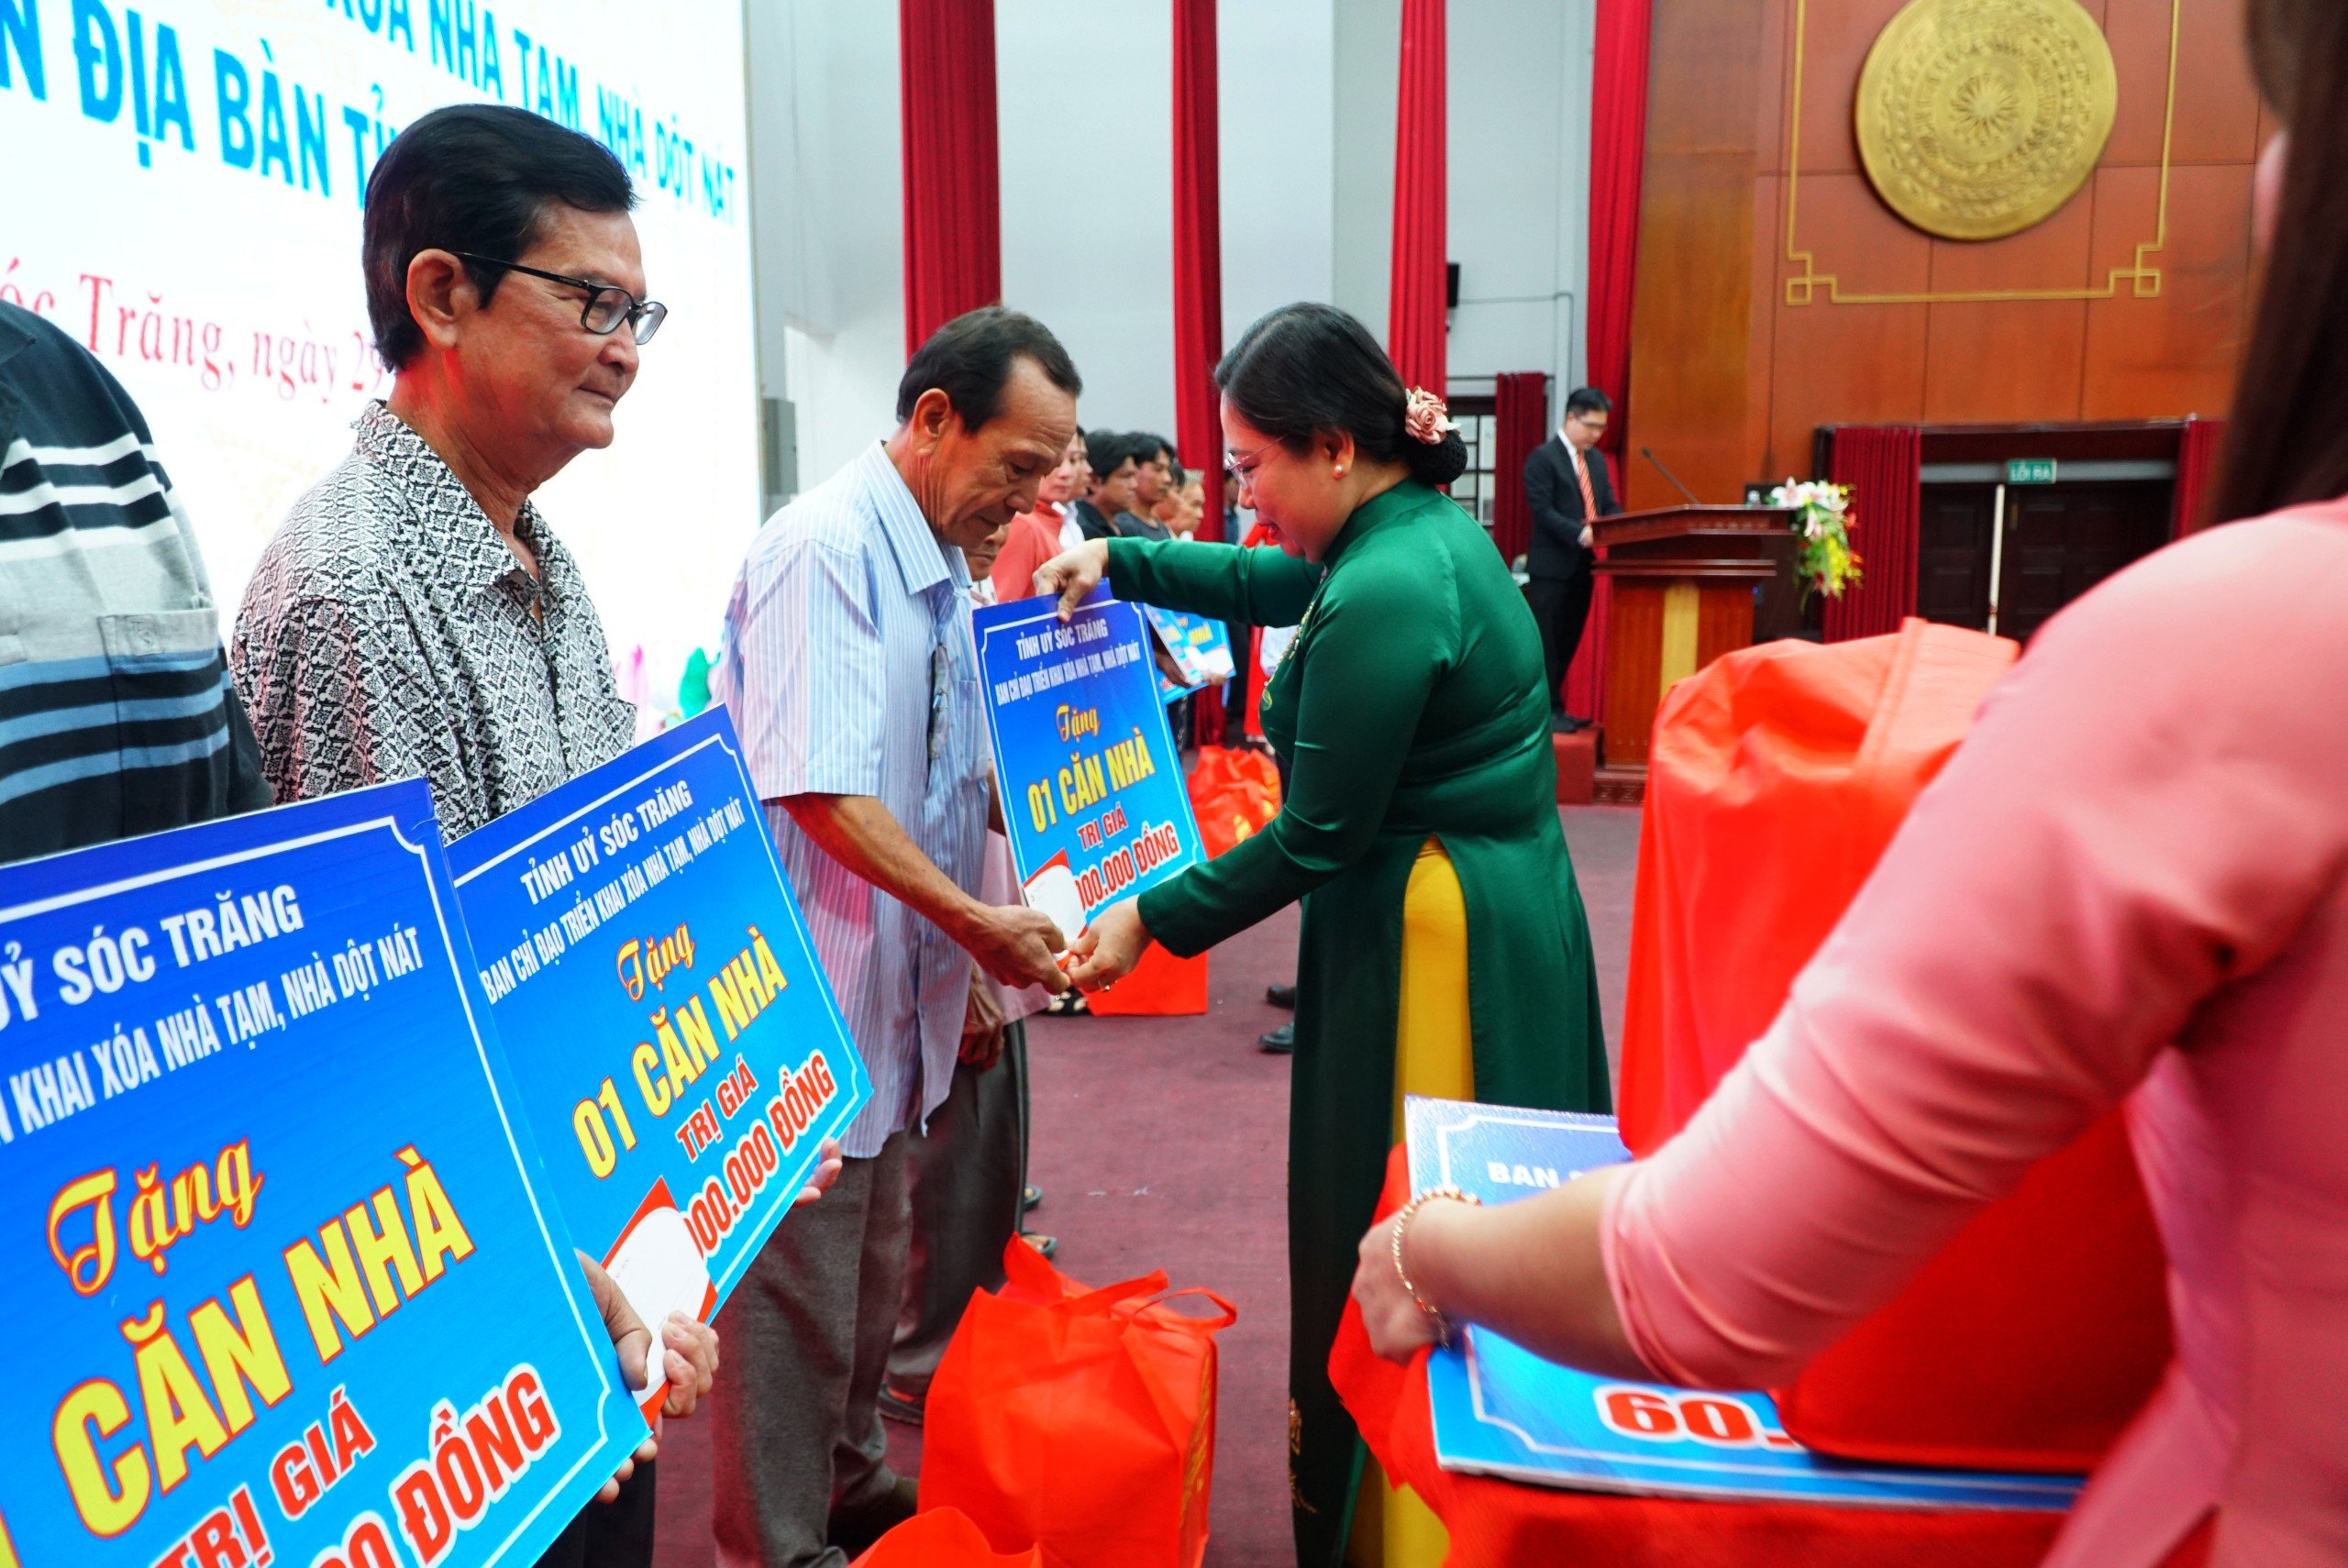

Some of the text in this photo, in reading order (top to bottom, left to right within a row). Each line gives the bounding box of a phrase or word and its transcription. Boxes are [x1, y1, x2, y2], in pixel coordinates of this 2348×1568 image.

[72, 0, 195, 169] ĐỊA
[214, 38, 331, 198] BÀN
[80, 272, 234, 391] Trăng,
[253, 318, 337, 404] ngày
[1015, 618, 1109, 660] TỈNH UỶ SÓC TRĂNG
[1027, 726, 1156, 834] 01 CĂN NHÀ
[1056, 702, 1101, 743] Tặng
[520, 779, 693, 906] TỈNH UỶ SÓC TRĂNG
[1077, 801, 1128, 852] TRỊ GIÁ
[1131, 820, 1182, 873] ĐỒNG
[52, 924, 156, 1006] SÓC
[160, 885, 305, 968] TRĂNG
[479, 796, 747, 1006] BAN CHỈ ĐẠO TRIỂN KHAI XÓA NHÀ TẠM, NHÀ DỘT NÁT
[615, 921, 696, 1002] Tặng
[8, 1051, 96, 1135] KHAI
[90, 1021, 161, 1100] XÓA
[155, 993, 222, 1072] NHÀ
[216, 980, 286, 1050] TẠM,
[281, 951, 337, 1019] NHÀ
[335, 937, 379, 1000] DỘT
[377, 926, 425, 986] NÁT
[572, 924, 789, 1180] 01 CĂN NHÀ
[676, 1053, 758, 1163] TRỊ GIÁ
[766, 1048, 838, 1154] ĐỒNG
[47, 1135, 264, 1297] Tặng
[1487, 1161, 1561, 1189] BAN
[51, 1143, 477, 1540] CĂN NHÀ
[270, 1383, 377, 1521] GIÁ
[388, 1363, 561, 1566] ĐỒNG
